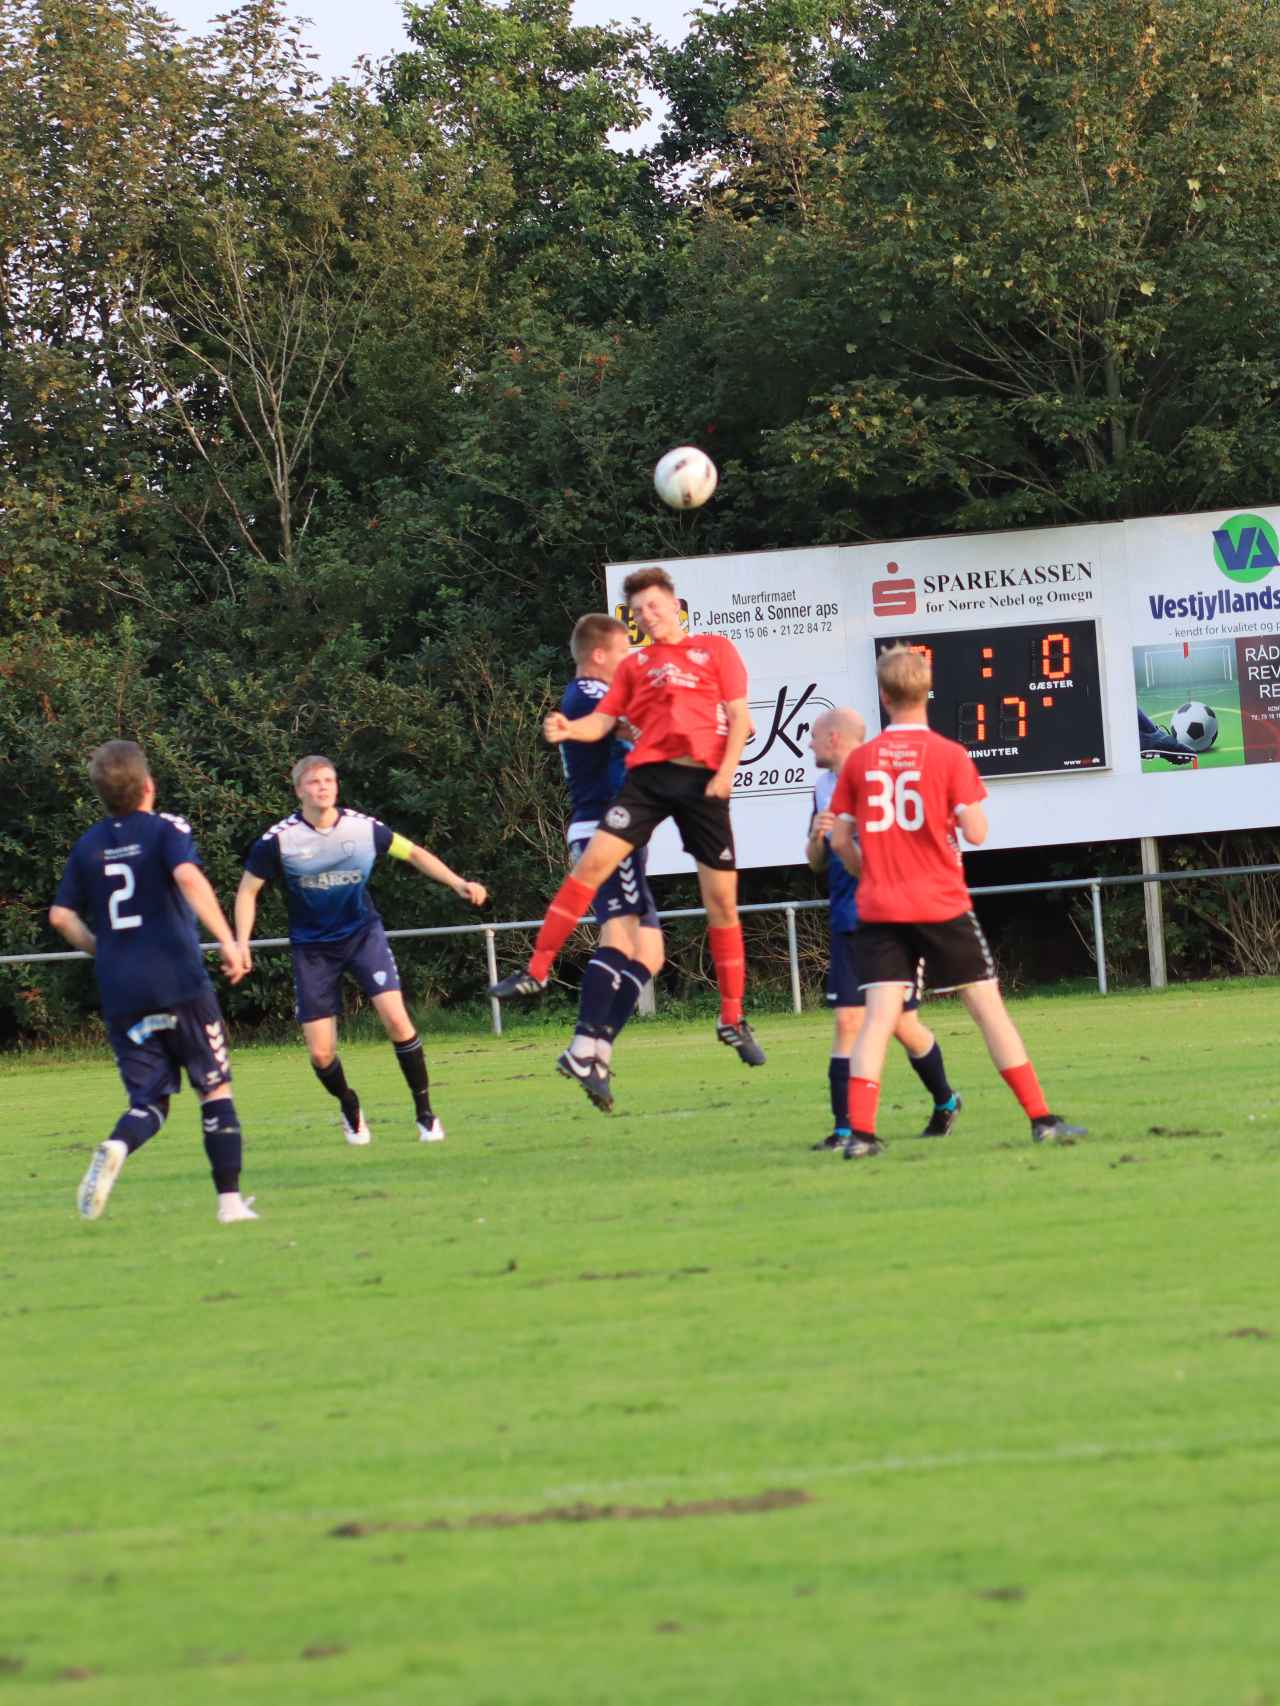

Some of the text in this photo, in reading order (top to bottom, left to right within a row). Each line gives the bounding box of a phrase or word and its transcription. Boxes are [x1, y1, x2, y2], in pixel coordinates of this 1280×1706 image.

[923, 561, 1093, 594] SPAREKASSEN
[731, 589, 797, 606] Murerfirmaet
[926, 589, 1093, 614] for Nørre Nebel og Omegn
[692, 602, 839, 626] P. Jensen & Sønner aps
[731, 629, 742, 640] 25
[745, 628, 755, 639] 15
[757, 626, 769, 637] 06
[781, 625, 791, 636] 21
[793, 623, 805, 635] 22
[807, 622, 819, 633] 84
[821, 621, 833, 632] 72
[1175, 627, 1203, 638] kendt
[1205, 625, 1219, 636] for
[1221, 621, 1258, 633] kvalitet
[1260, 622, 1274, 633] og
[1042, 633, 1071, 679] 0
[1029, 679, 1074, 691] GÆSTER
[733, 768, 805, 787] 28 20 02
[865, 770, 925, 832] 36
[104, 863, 143, 930] 2
